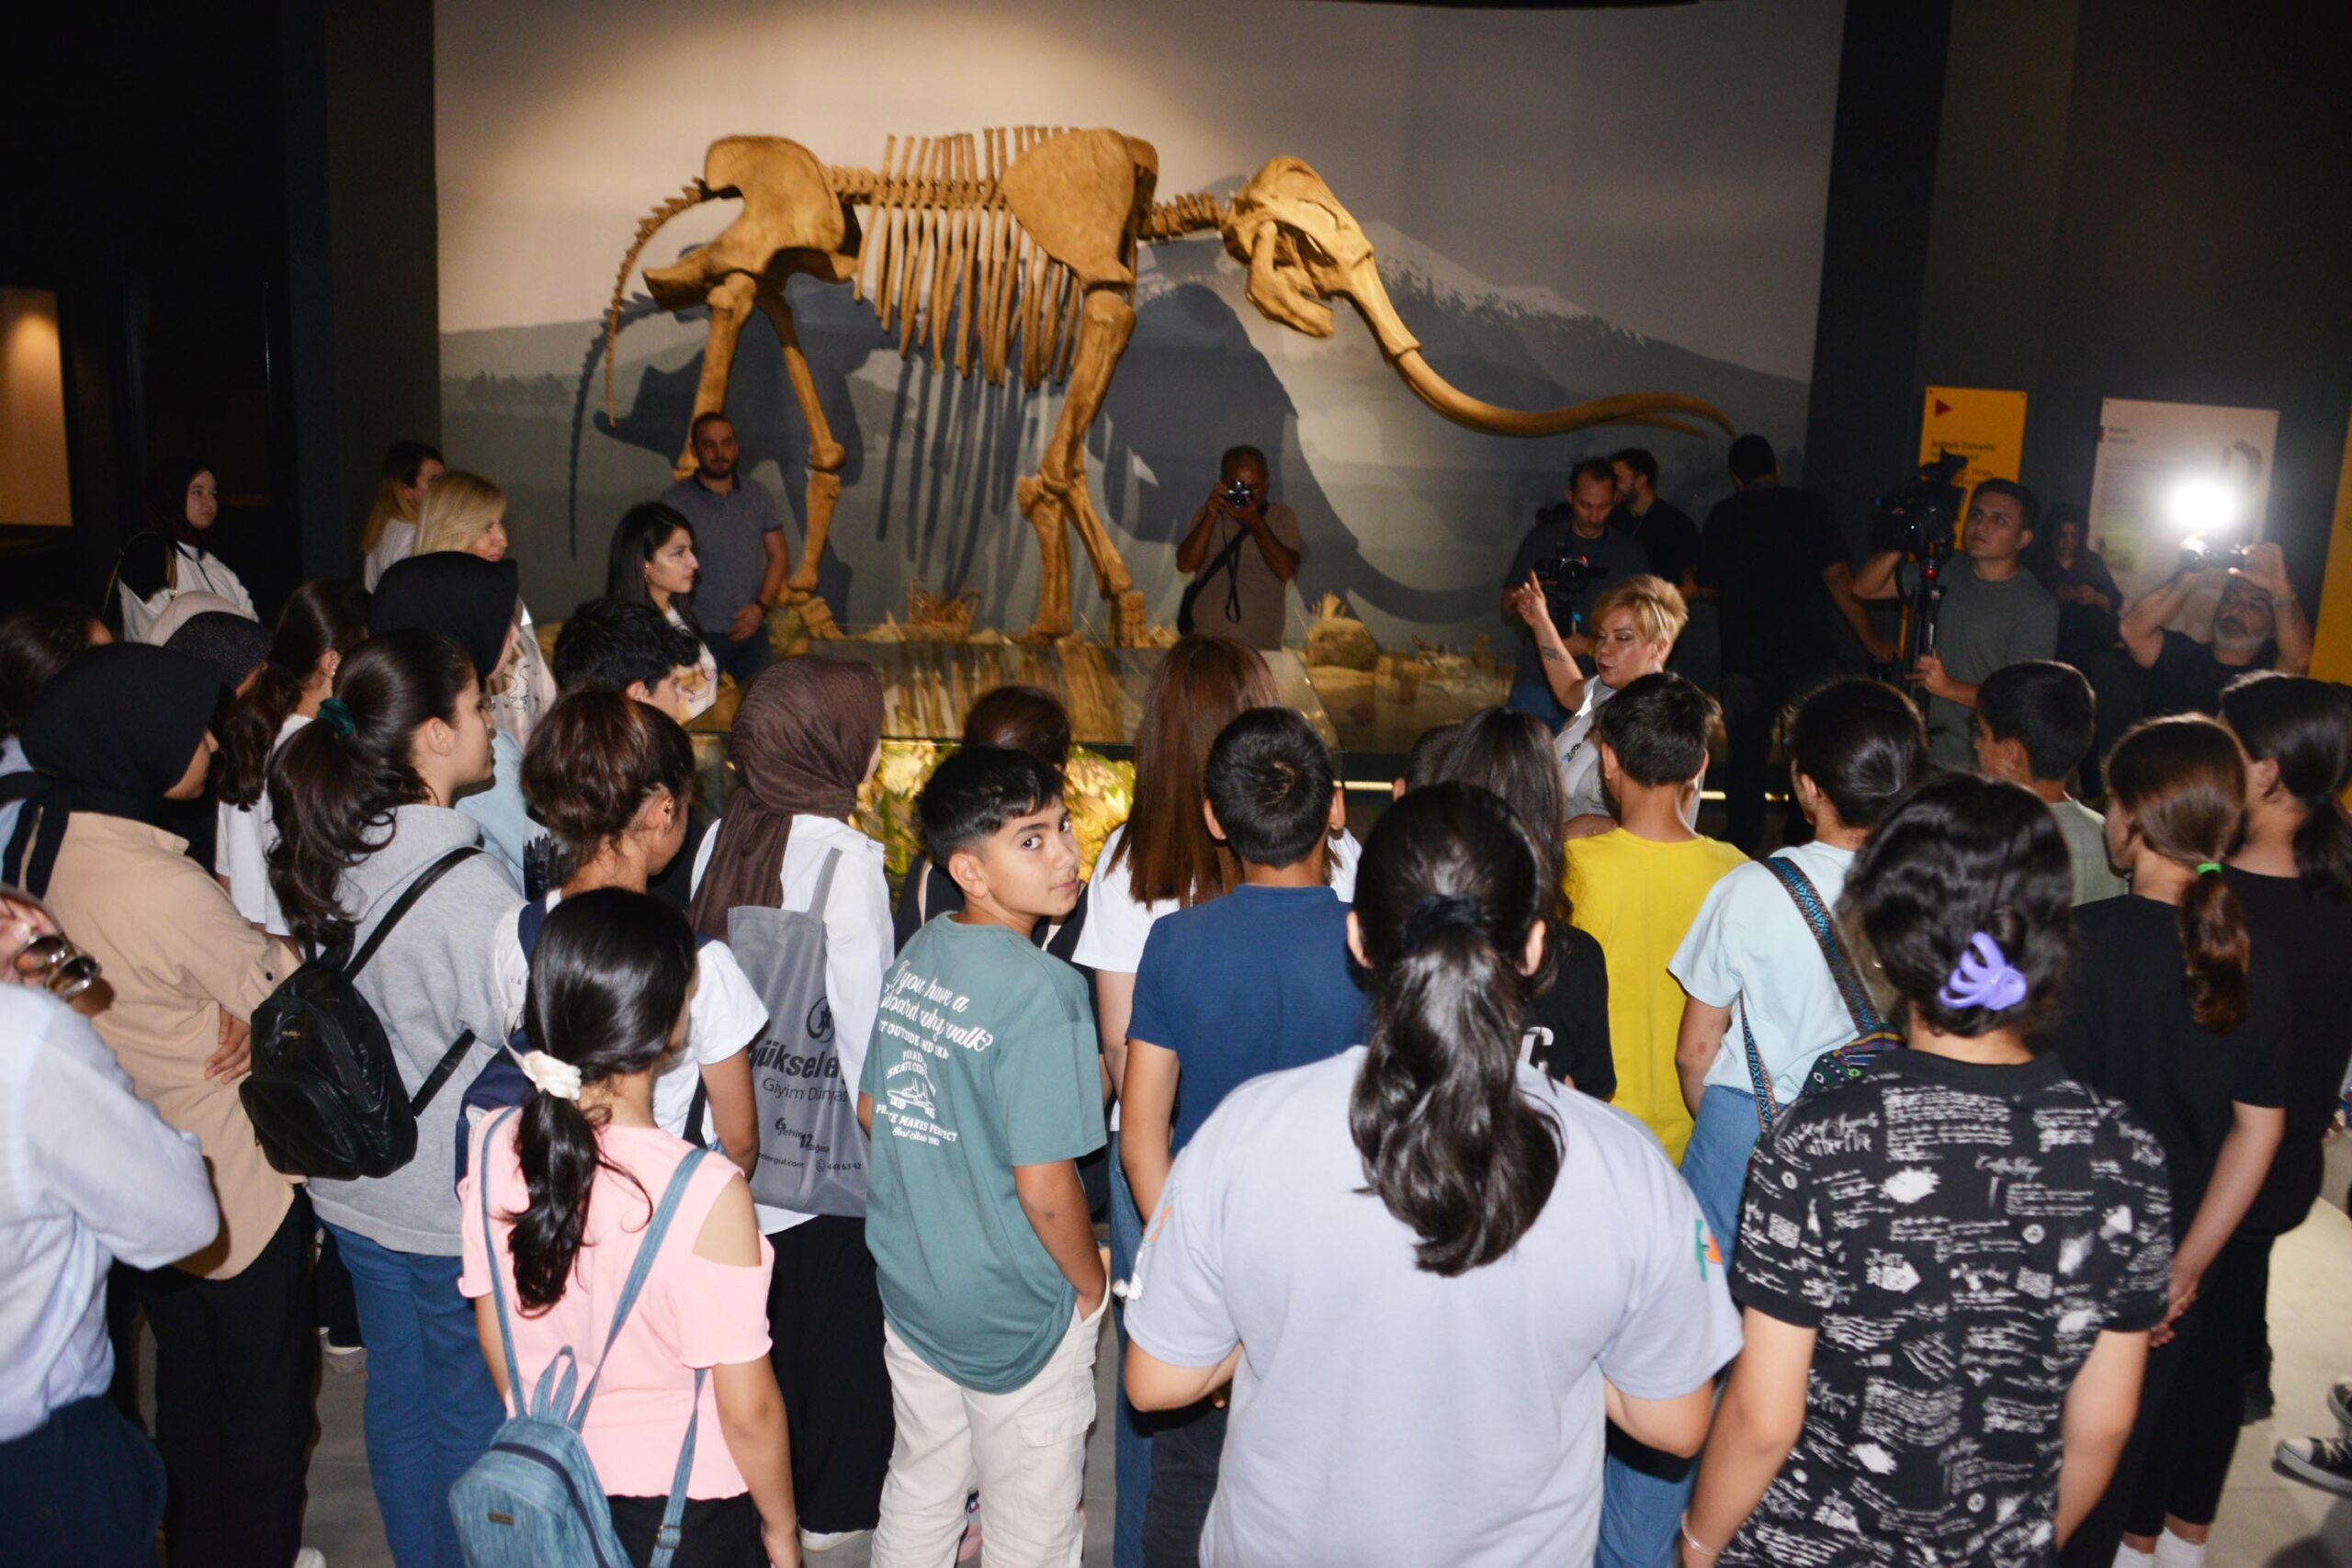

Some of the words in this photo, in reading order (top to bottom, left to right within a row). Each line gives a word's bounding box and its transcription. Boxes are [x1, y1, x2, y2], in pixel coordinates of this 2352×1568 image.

[896, 971, 926, 995] you
[923, 977, 953, 1007] have
[951, 995, 970, 1013] a
[920, 1009, 944, 1042] why
[945, 1021, 994, 1052] walk?
[762, 1077, 805, 1100] Giyim
[899, 1115, 928, 1132] MAKES
